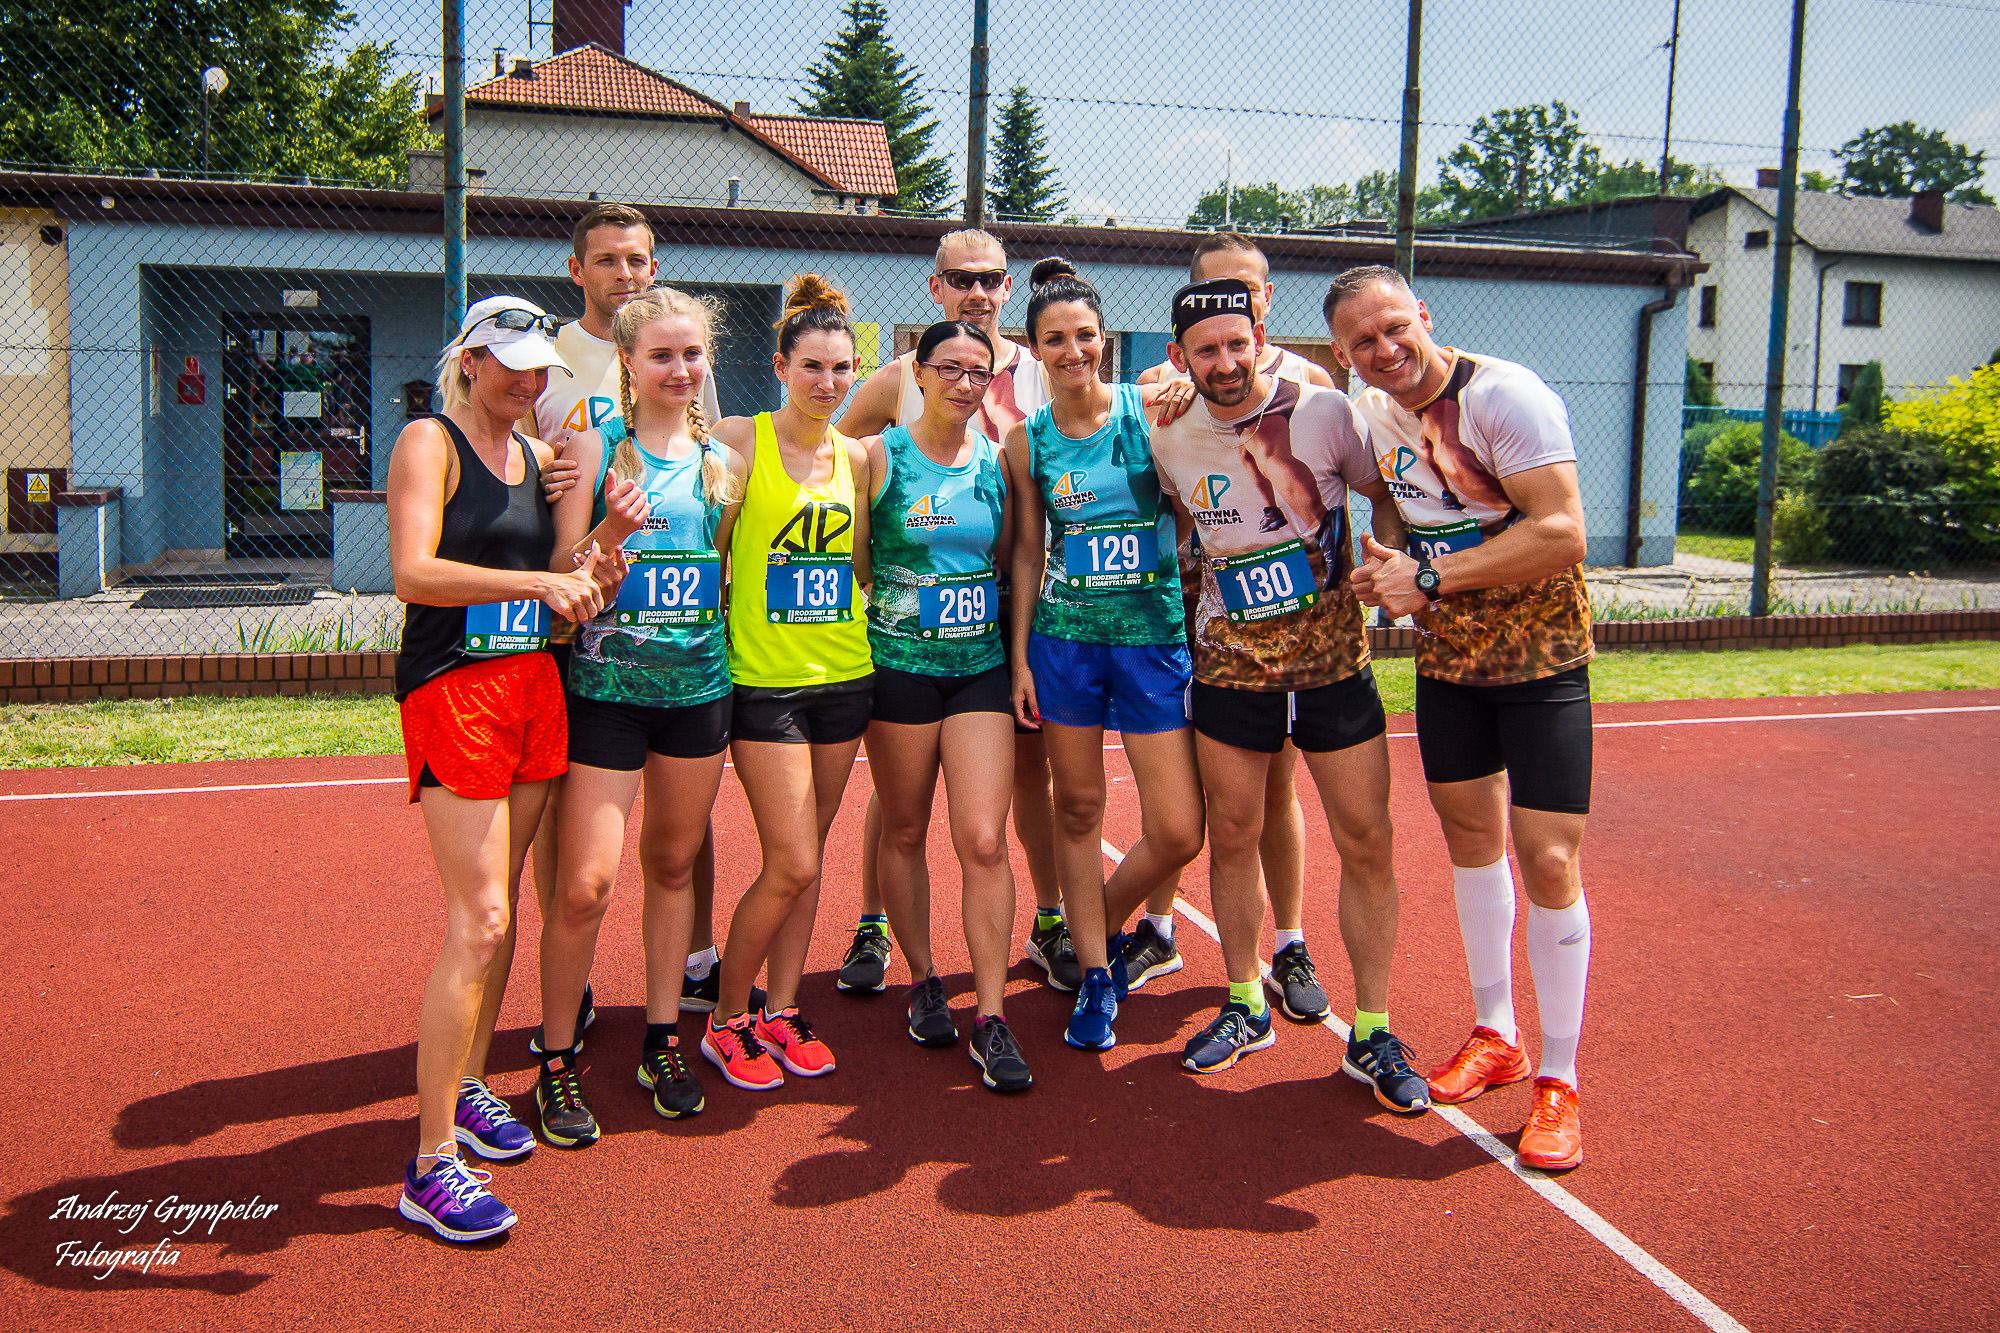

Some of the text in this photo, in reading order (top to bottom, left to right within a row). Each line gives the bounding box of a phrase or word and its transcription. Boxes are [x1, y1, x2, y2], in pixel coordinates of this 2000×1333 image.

[1180, 292, 1247, 309] ATTIQ
[906, 515, 955, 524] AKTYWNA
[906, 520, 957, 528] PSZCZYNA.PL
[1087, 534, 1140, 572] 129
[643, 566, 701, 607] 132
[792, 568, 839, 607] 133
[1235, 561, 1294, 606] 130
[499, 599, 540, 632] 121
[939, 585, 986, 625] 269
